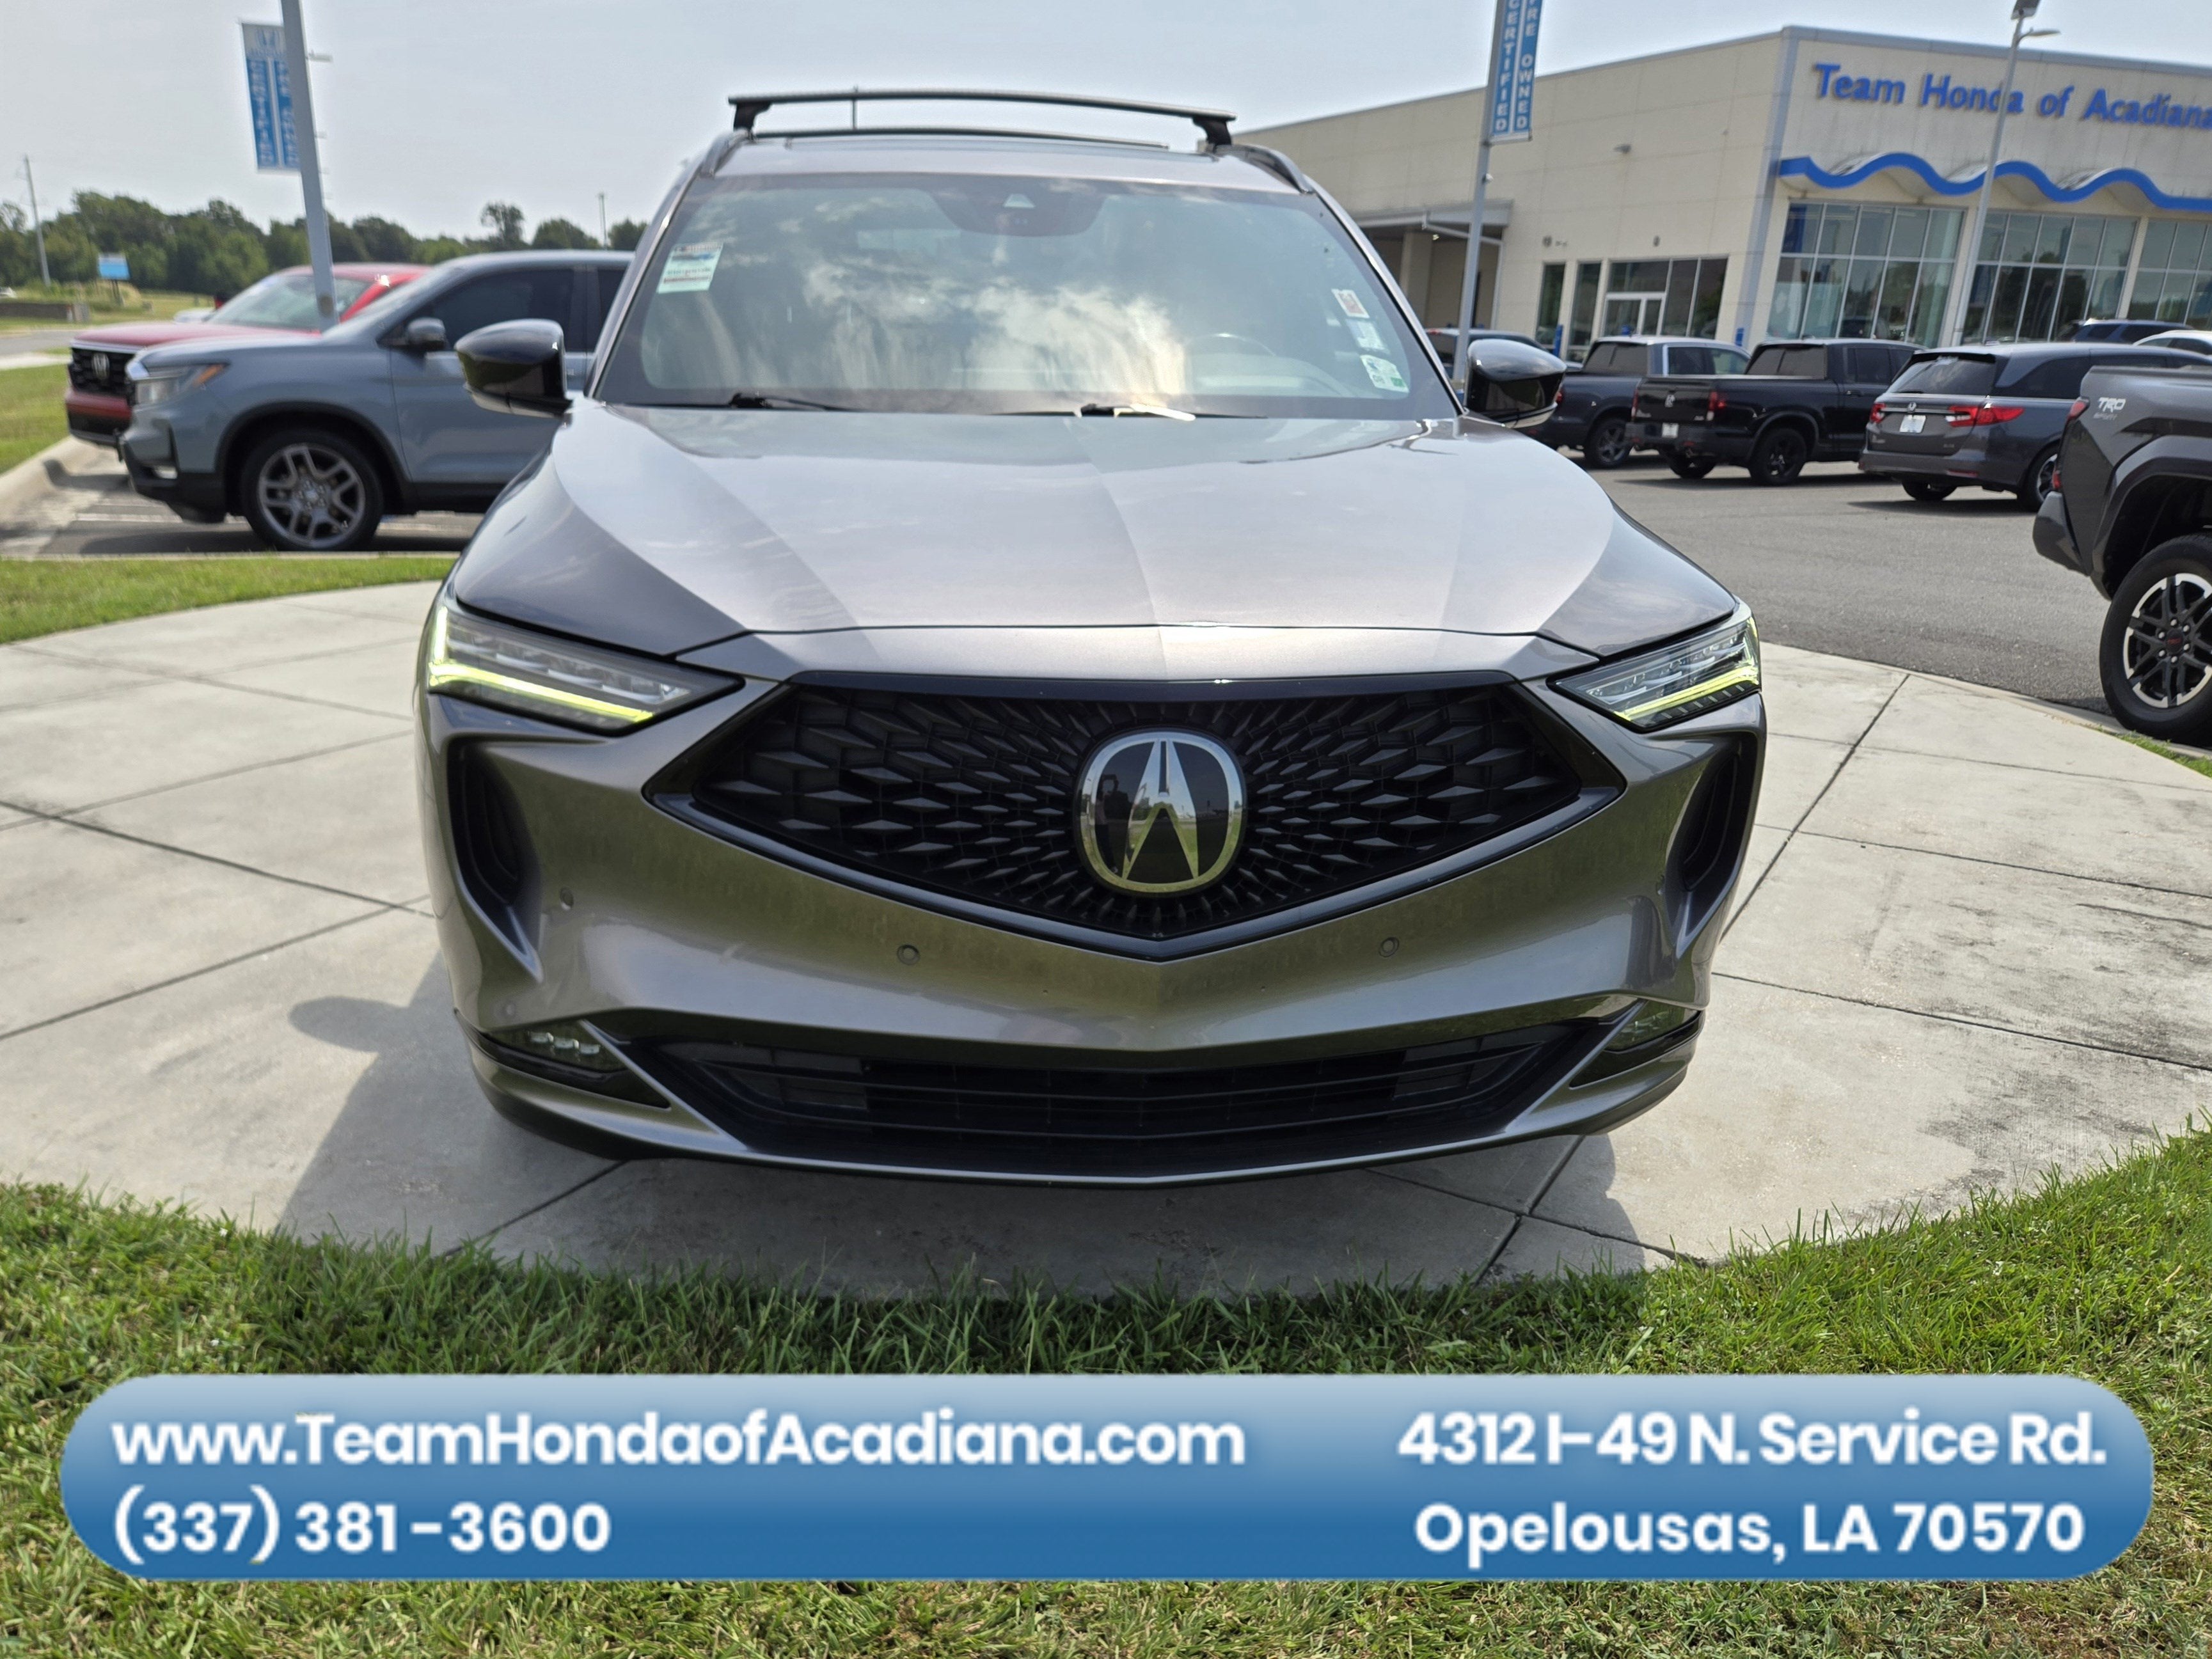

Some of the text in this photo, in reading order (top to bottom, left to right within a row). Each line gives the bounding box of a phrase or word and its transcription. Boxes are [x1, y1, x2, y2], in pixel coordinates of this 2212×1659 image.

[1815, 63, 1906, 103] Team
[2039, 86, 2075, 116] of
[2083, 88, 2212, 129] Acadiana
